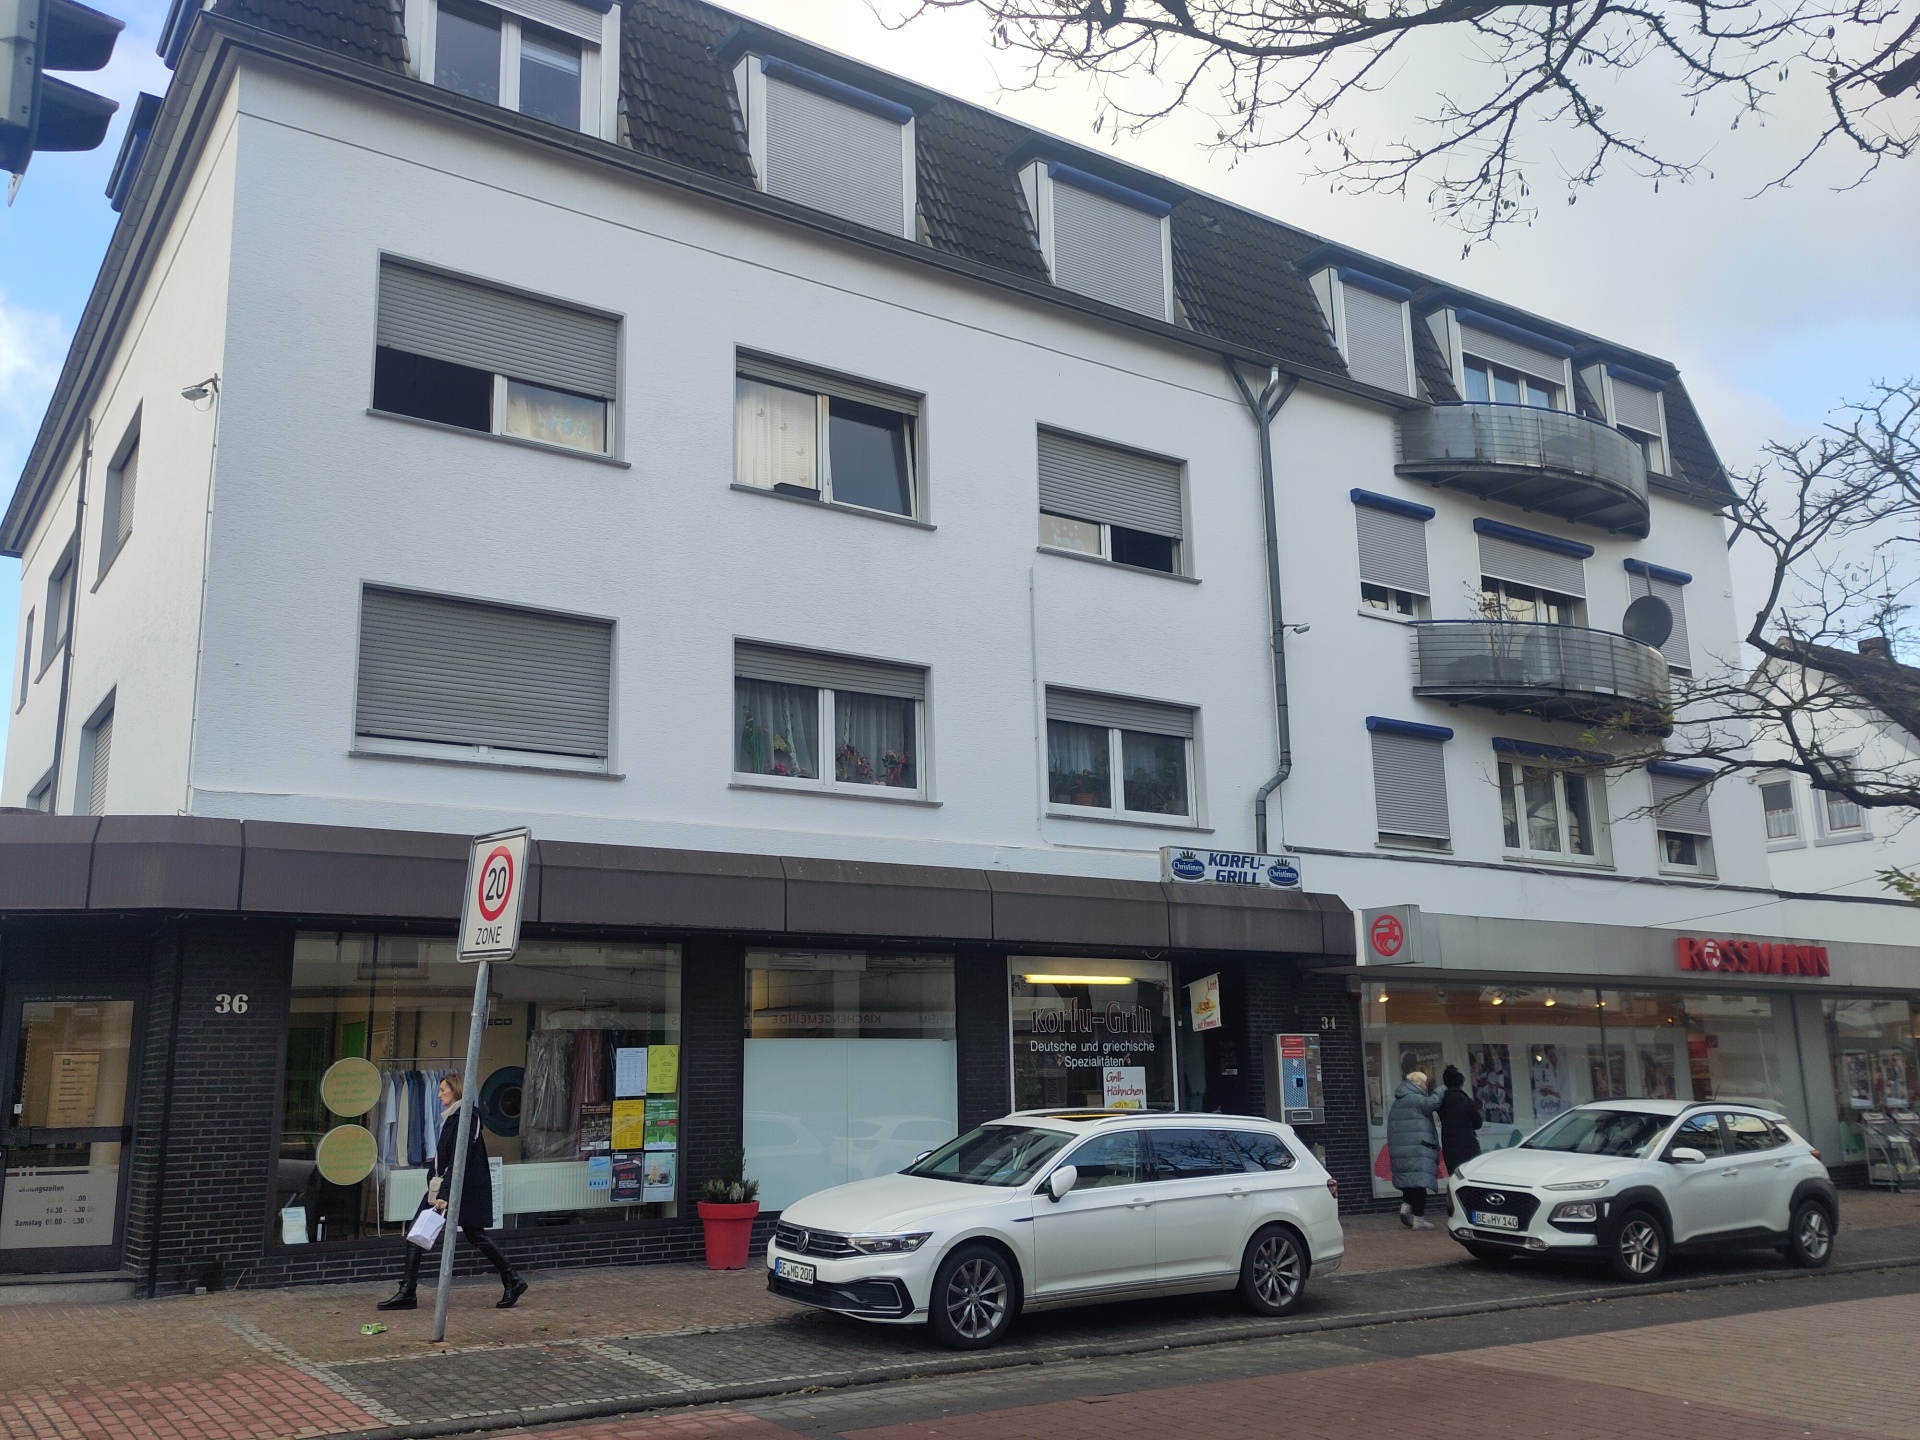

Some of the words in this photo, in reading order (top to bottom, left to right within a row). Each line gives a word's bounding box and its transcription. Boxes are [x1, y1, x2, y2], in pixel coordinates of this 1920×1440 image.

[1172, 860, 1204, 872] Christinen
[1208, 852, 1265, 870] KORFU-
[1215, 869, 1261, 885] GRILL
[1268, 869, 1298, 879] Christinen
[485, 866, 507, 901] 20
[475, 926, 503, 945] ZONE
[1677, 937, 1831, 977] ROSSMANN
[214, 993, 249, 1014] 36
[1030, 996, 1152, 1034] Korfu-Grill
[1321, 1016, 1337, 1030] 34
[1030, 1040, 1077, 1052] Deutsche
[1081, 1040, 1099, 1052] und
[1102, 1040, 1155, 1054] griechische
[1064, 1055, 1125, 1069] Spezialitäten
[1105, 1071, 1125, 1083] Grill-
[1107, 1084, 1144, 1097] Hähnchen
[15, 1219, 42, 1228] Samstag
[45, 1218, 63, 1226] 0.00
[1477, 1214, 1486, 1224] BE
[1491, 1216, 1501, 1226] HY
[1503, 1218, 1517, 1228] 140
[779, 1261, 787, 1275] BE
[791, 1265, 799, 1278] MG
[800, 1267, 812, 1281] 200
